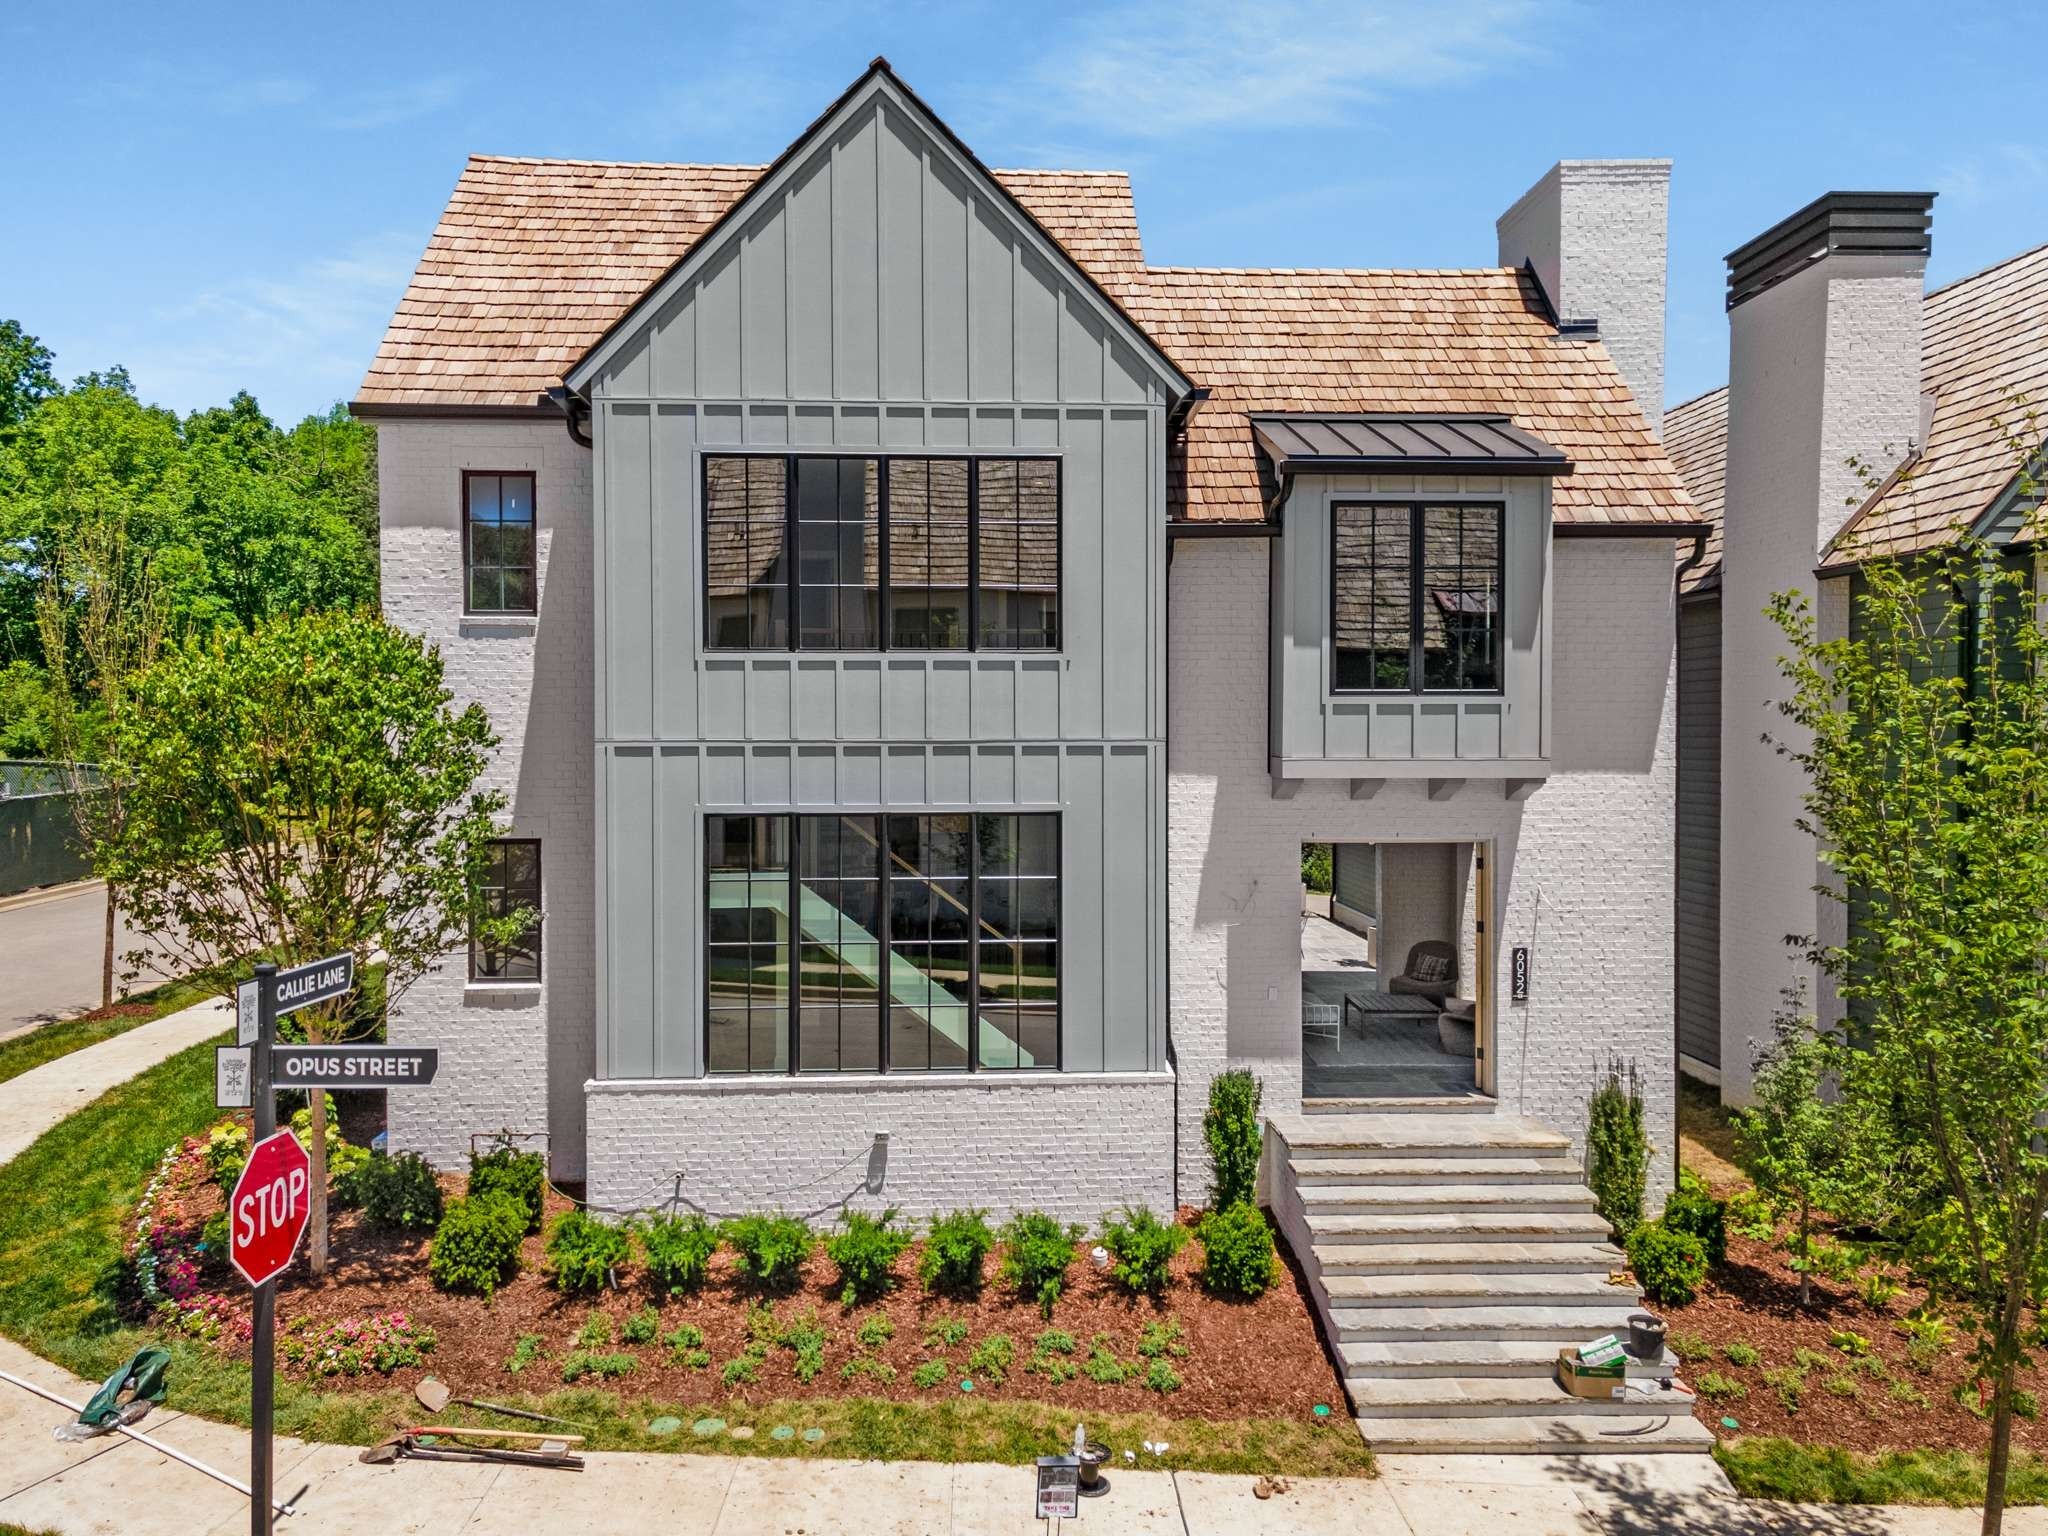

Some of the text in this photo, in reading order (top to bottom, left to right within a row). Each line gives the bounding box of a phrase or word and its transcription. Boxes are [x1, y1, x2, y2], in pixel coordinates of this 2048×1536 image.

[277, 966, 345, 1002] CALLIE LANE
[1516, 949, 1525, 994] 6052
[286, 1057, 422, 1076] OPUS STREET
[238, 1167, 305, 1248] STOP
